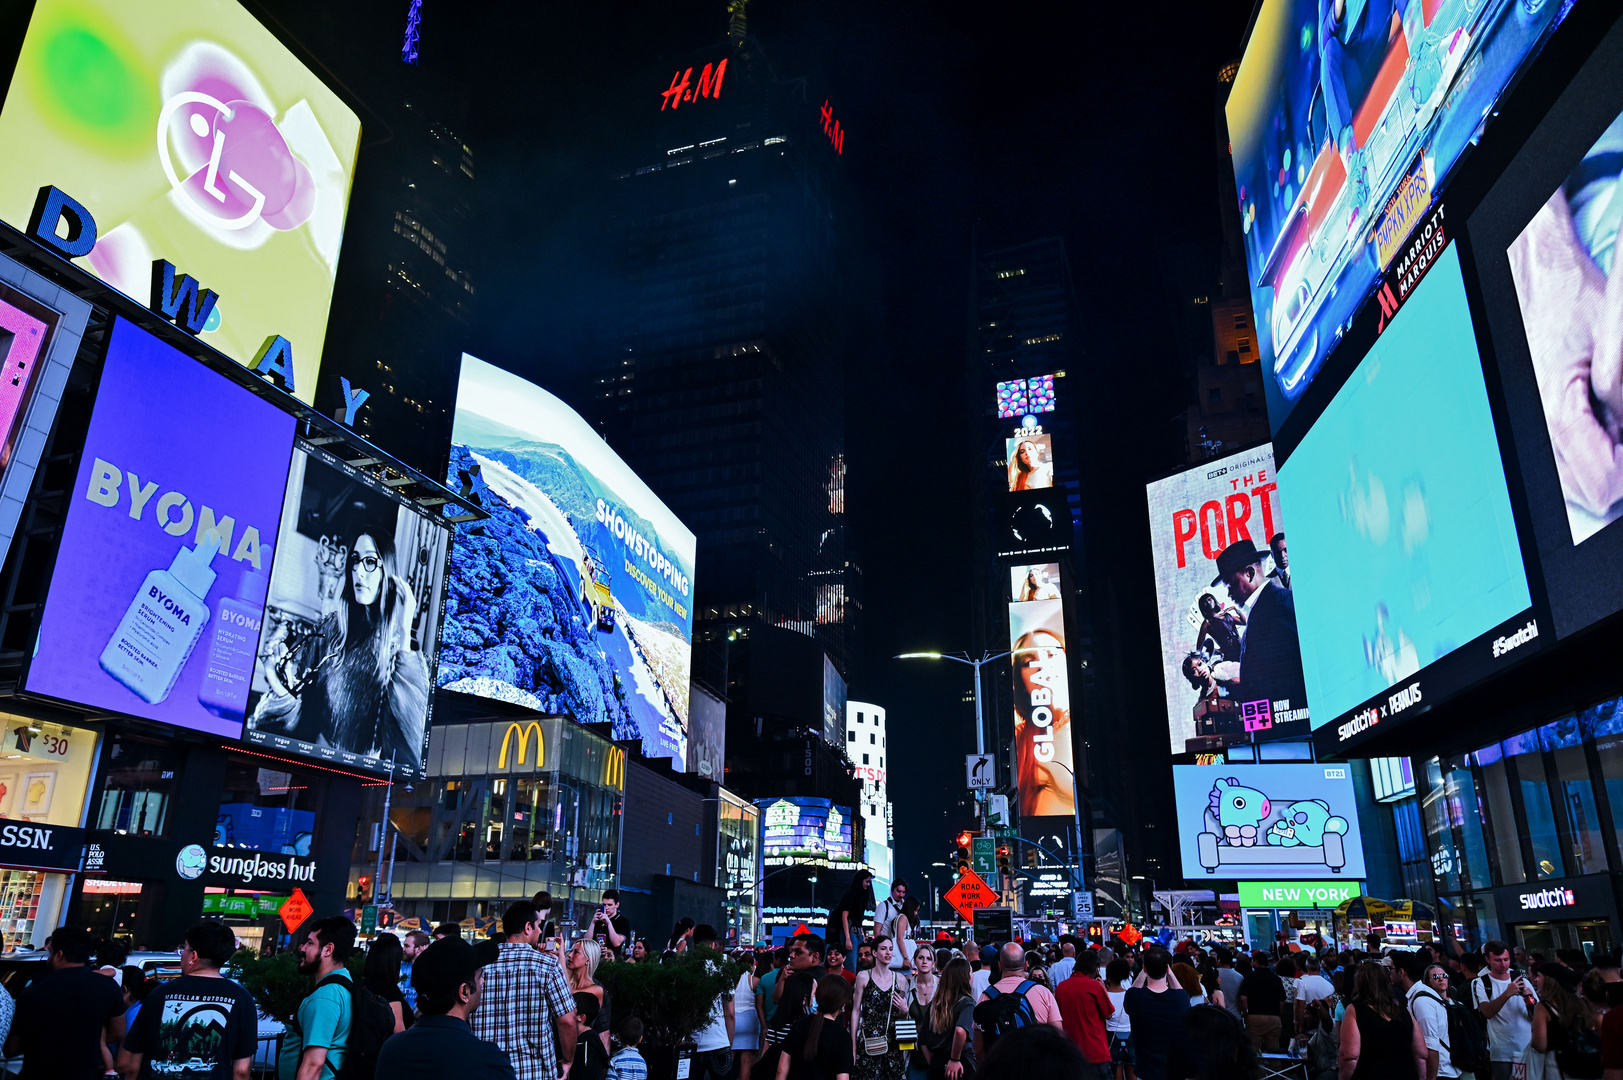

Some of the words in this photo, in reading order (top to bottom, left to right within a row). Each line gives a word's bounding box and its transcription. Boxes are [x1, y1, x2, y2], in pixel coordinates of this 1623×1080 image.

[661, 58, 728, 111] H&M
[820, 99, 844, 155] H&M
[1377, 198, 1405, 258] PMPKN
[1403, 167, 1427, 220] XPRS
[1397, 204, 1445, 280] MARRIOTT
[1400, 232, 1444, 297] MARQUIS
[1013, 425, 1043, 438] 2022
[1229, 456, 1265, 472] ORIGINAL
[1230, 469, 1267, 491] THE
[85, 457, 262, 570] BYOMA
[595, 498, 689, 597] SHOWSTOPPING
[625, 559, 657, 595] DISCOVER
[657, 586, 674, 609] YOUR
[674, 600, 687, 620] NEW
[137, 608, 155, 625] SERUM
[148, 585, 191, 626] BYOMA
[140, 603, 175, 633] BRIGHTENING
[221, 609, 261, 631] BYOMA
[120, 638, 141, 655] BOOSTED
[216, 635, 234, 645] SERUM
[218, 629, 247, 642] HYDRATING
[117, 643, 134, 658] BETTER
[1029, 654, 1056, 763] GLOBAL
[1273, 699, 1290, 713] NOW
[1338, 708, 1373, 742] swatch
[1388, 682, 1422, 715] PEANUTS
[43, 733, 69, 756] $30
[660, 738, 669, 748] LIVE
[669, 741, 679, 753] FREE
[971, 778, 991, 786] ONLY
[1326, 770, 1344, 778] BT21
[0, 825, 54, 850] SSN.
[1003, 829, 1011, 837] 45
[88, 850, 105, 858] POLO
[209, 855, 286, 883] sunglass
[287, 857, 317, 882] hut
[1262, 888, 1301, 901] NEW
[1305, 888, 1350, 901] YORK
[1519, 887, 1566, 910] swatch
[1077, 903, 1091, 912] 25
[773, 916, 788, 924] PGA
[202, 995, 236, 1005] OUTDOORS
